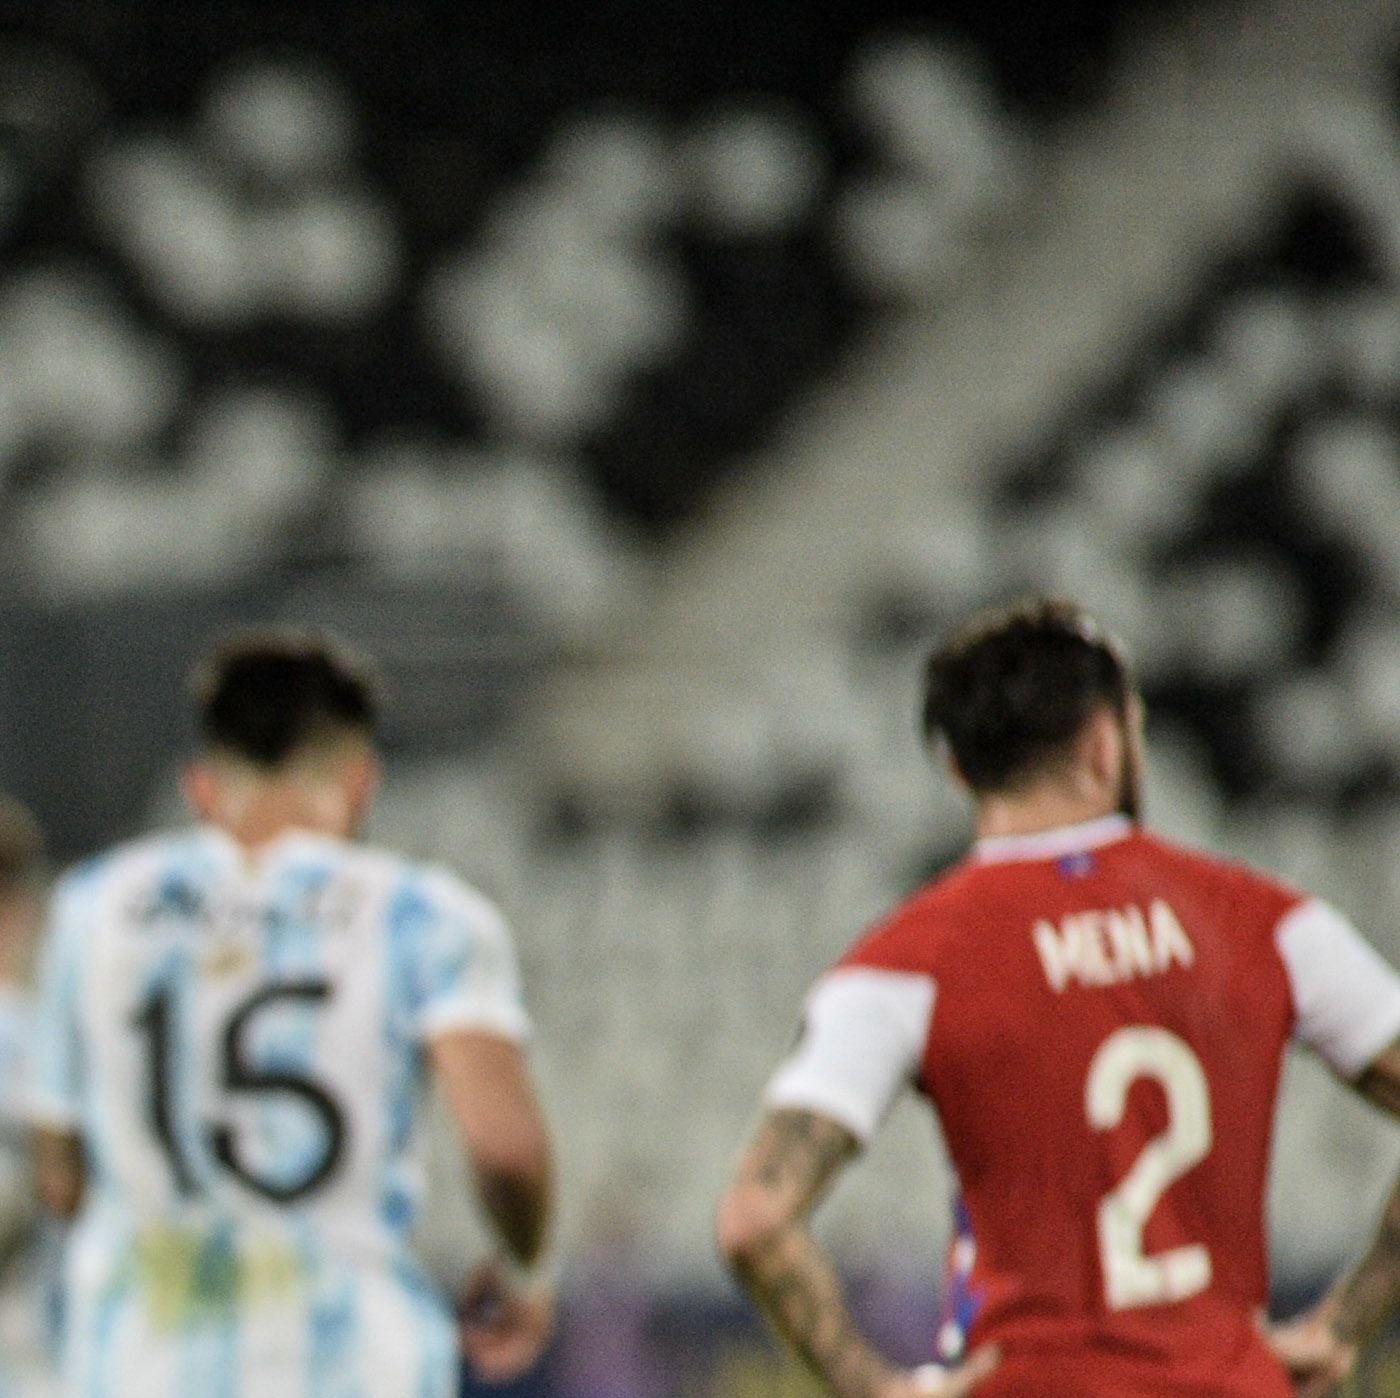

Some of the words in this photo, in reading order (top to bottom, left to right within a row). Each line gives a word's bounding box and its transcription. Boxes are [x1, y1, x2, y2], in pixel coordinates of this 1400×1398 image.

[1032, 898, 1196, 993] MENA
[126, 975, 348, 1206] 15
[1084, 1026, 1214, 1309] 2
